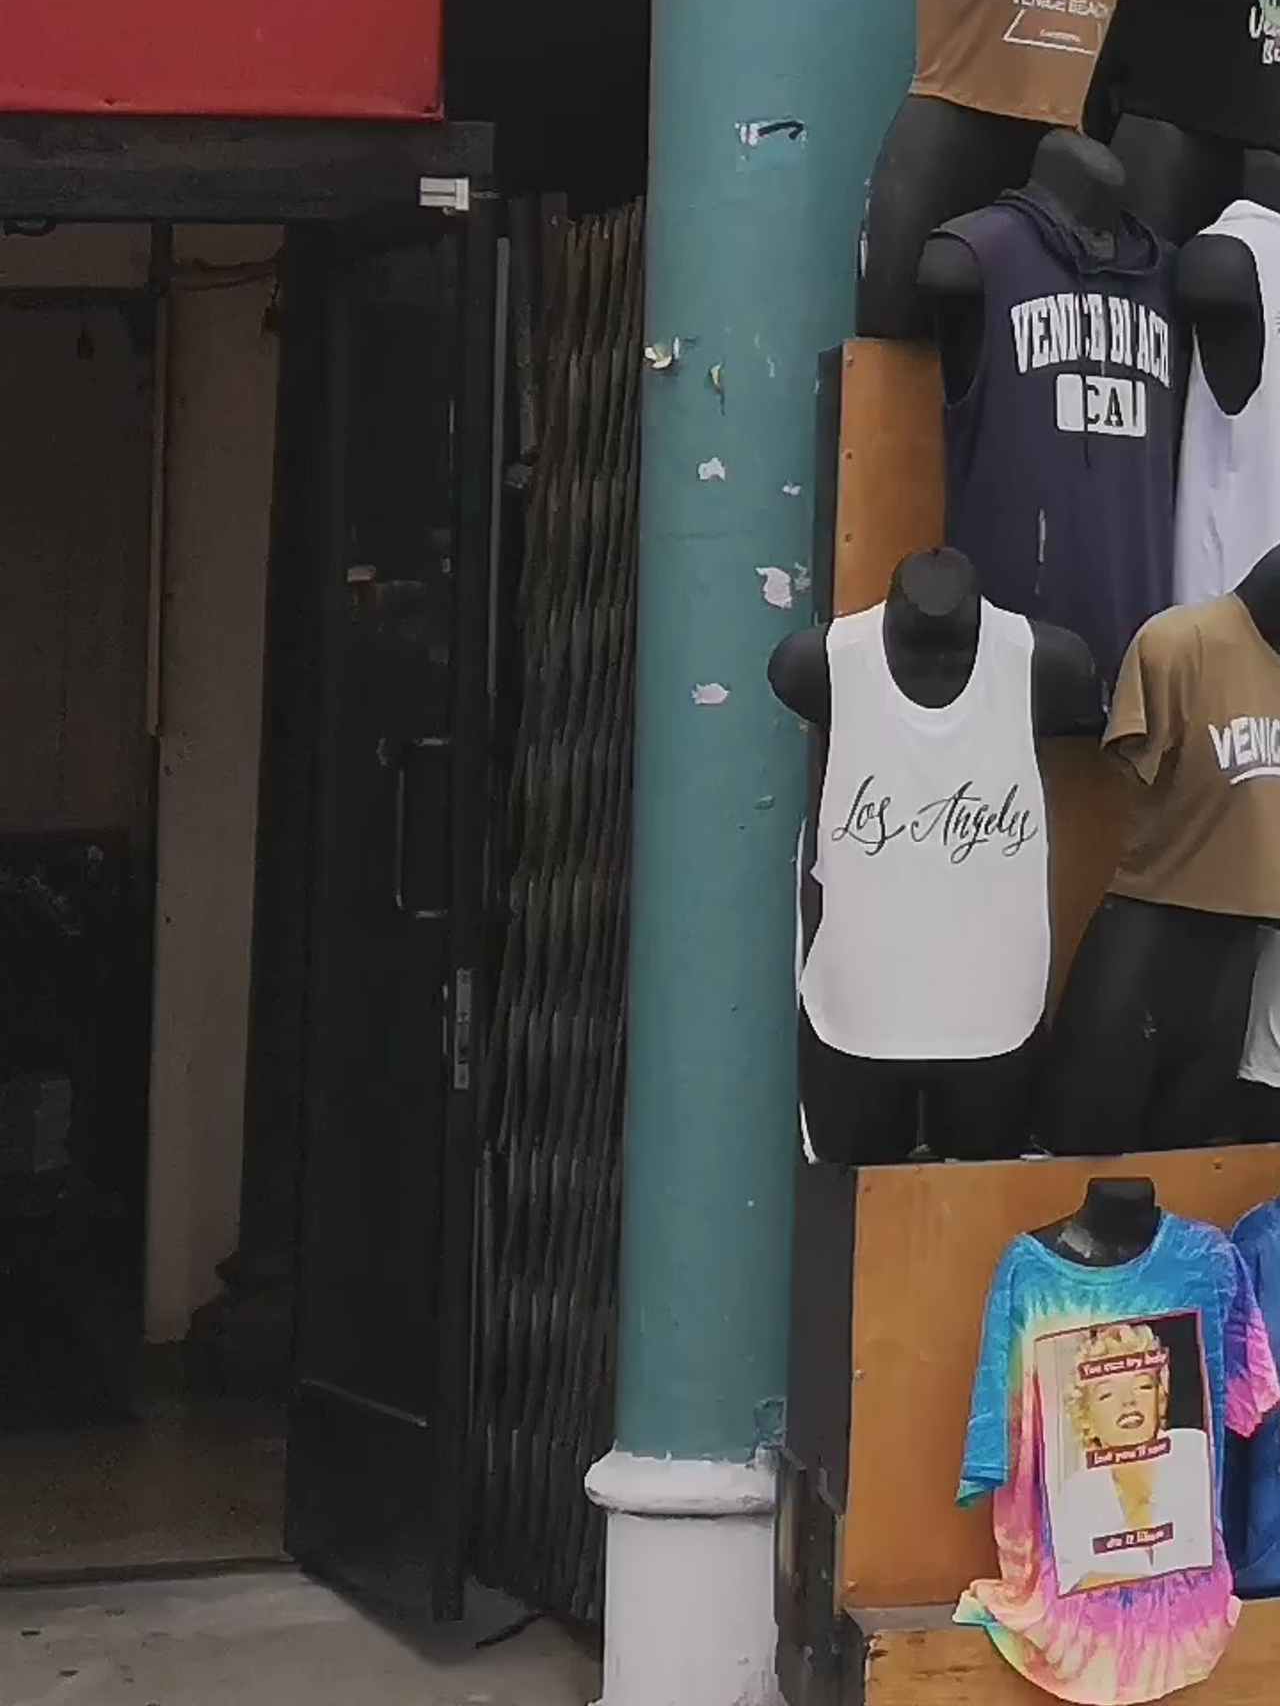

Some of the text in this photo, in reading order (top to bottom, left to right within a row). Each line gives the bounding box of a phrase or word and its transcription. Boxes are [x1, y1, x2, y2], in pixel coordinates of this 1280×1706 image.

[1011, 292, 1174, 390] VENICE BEACH
[831, 775, 1038, 864] Los Angeles
